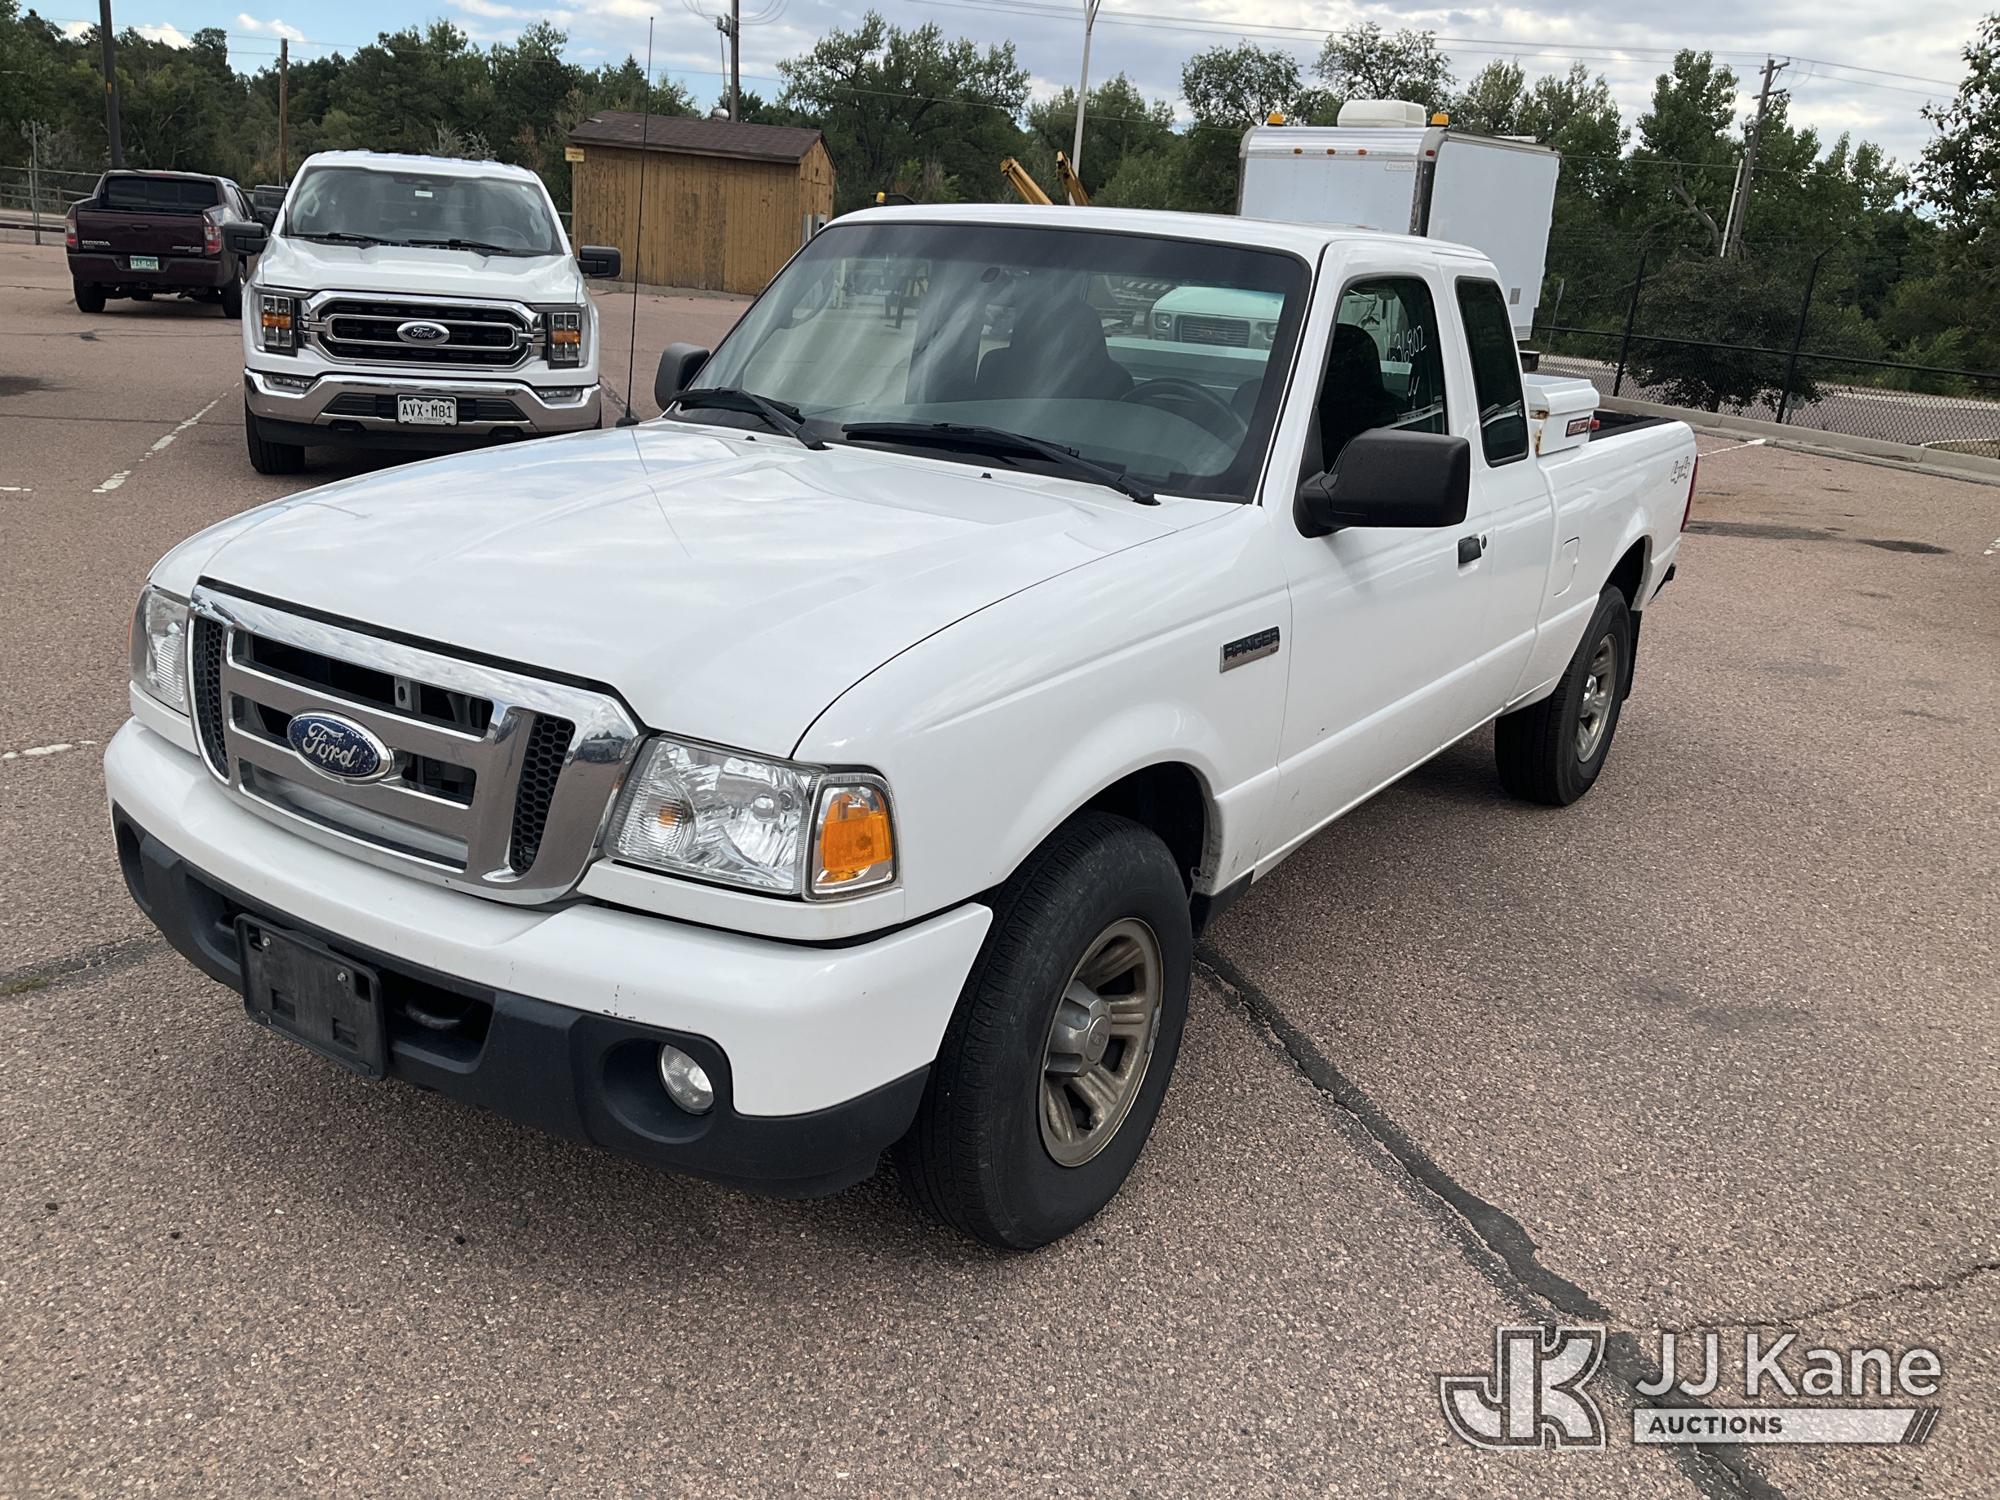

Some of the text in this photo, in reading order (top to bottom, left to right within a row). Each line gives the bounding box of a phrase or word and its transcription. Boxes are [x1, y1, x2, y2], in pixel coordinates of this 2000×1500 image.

[411, 327, 436, 338] Ford
[1223, 627, 1279, 660] RANGER
[303, 723, 357, 767] Ford
